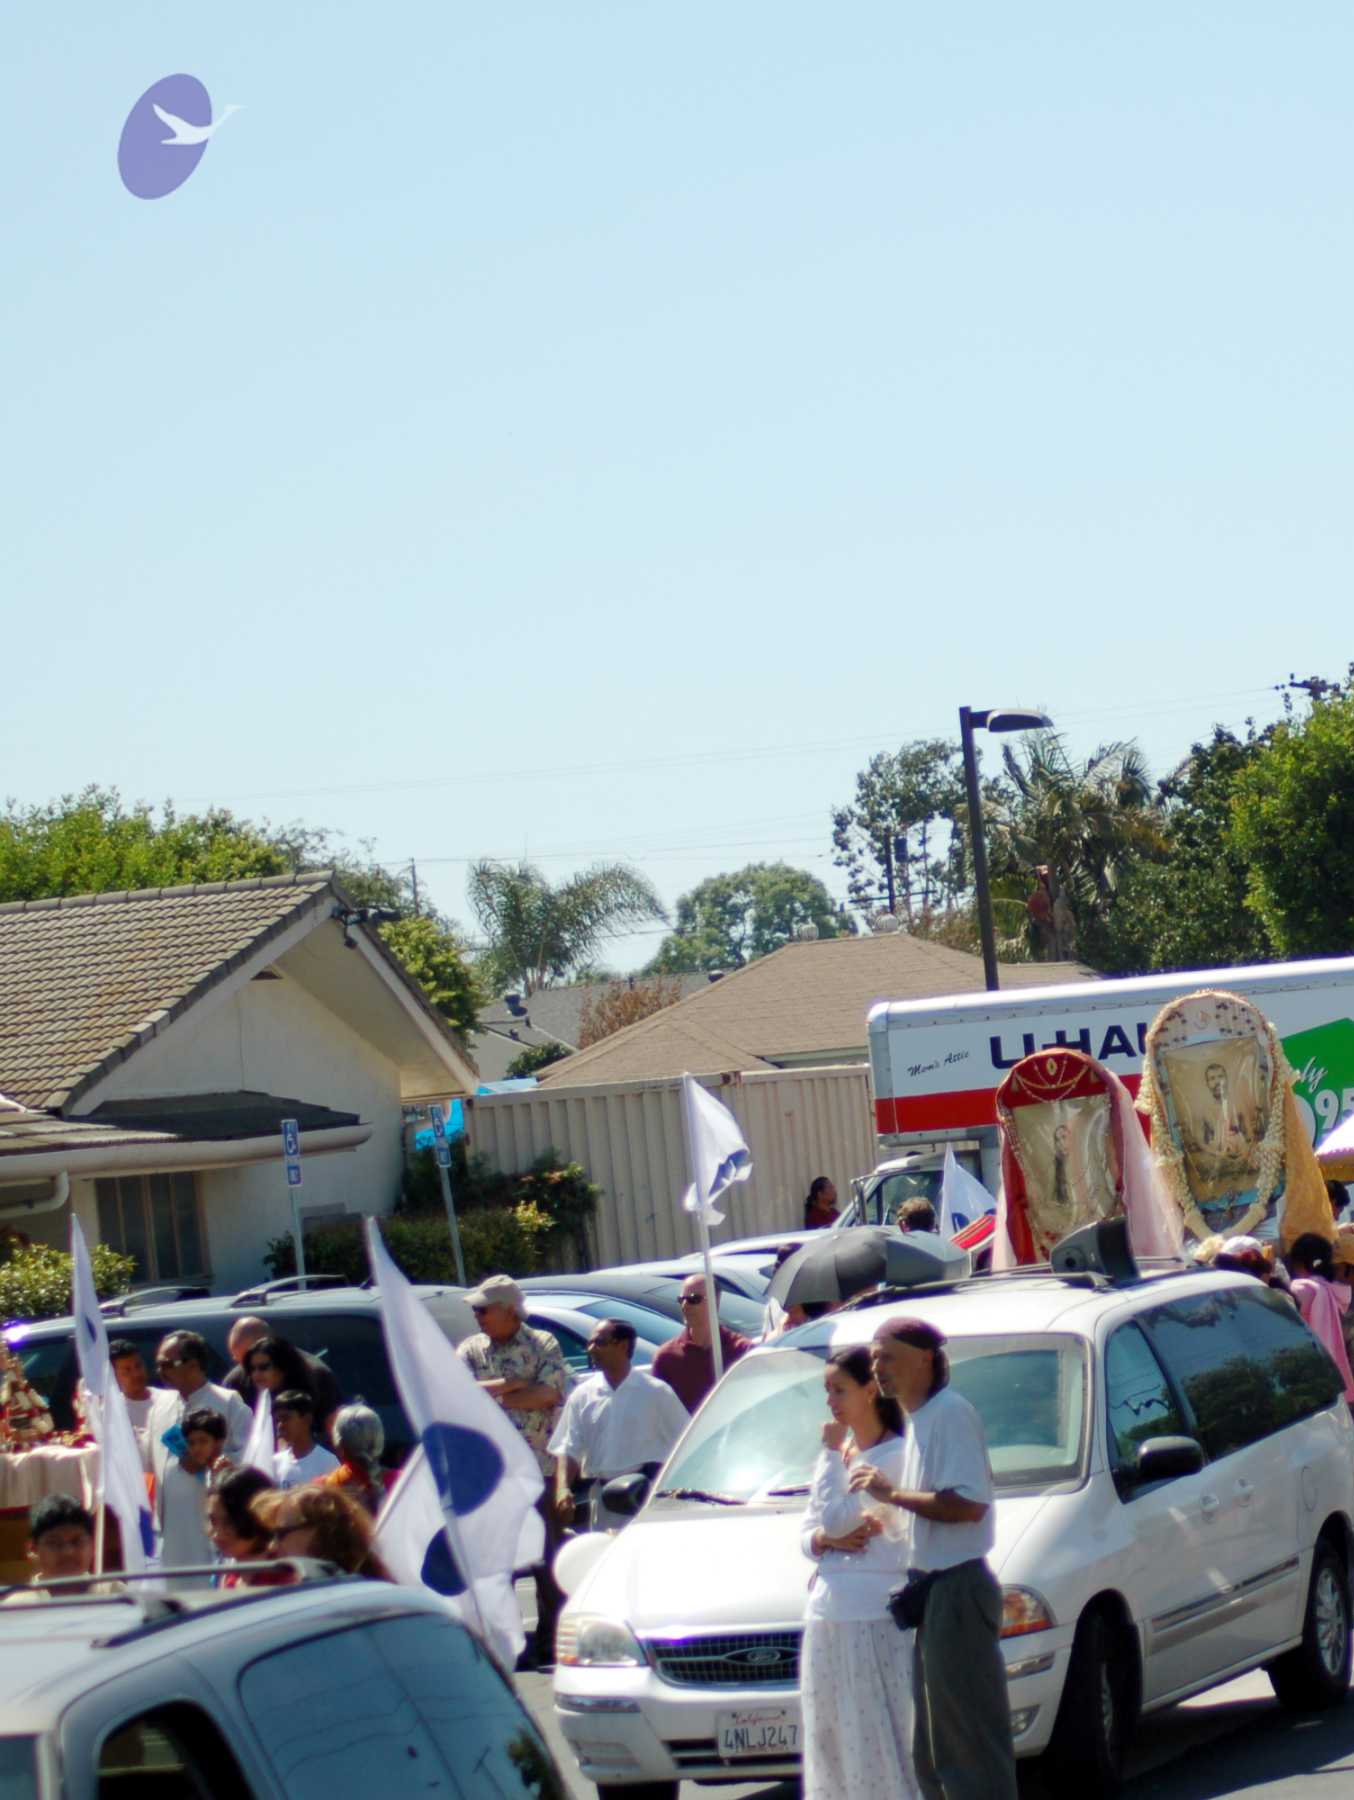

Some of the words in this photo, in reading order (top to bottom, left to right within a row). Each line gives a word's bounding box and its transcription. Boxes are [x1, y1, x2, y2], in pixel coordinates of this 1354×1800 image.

[989, 1022, 1148, 1070] U-HA
[1299, 1056, 1328, 1093] ly
[724, 1724, 798, 1749] 4NLJ247
